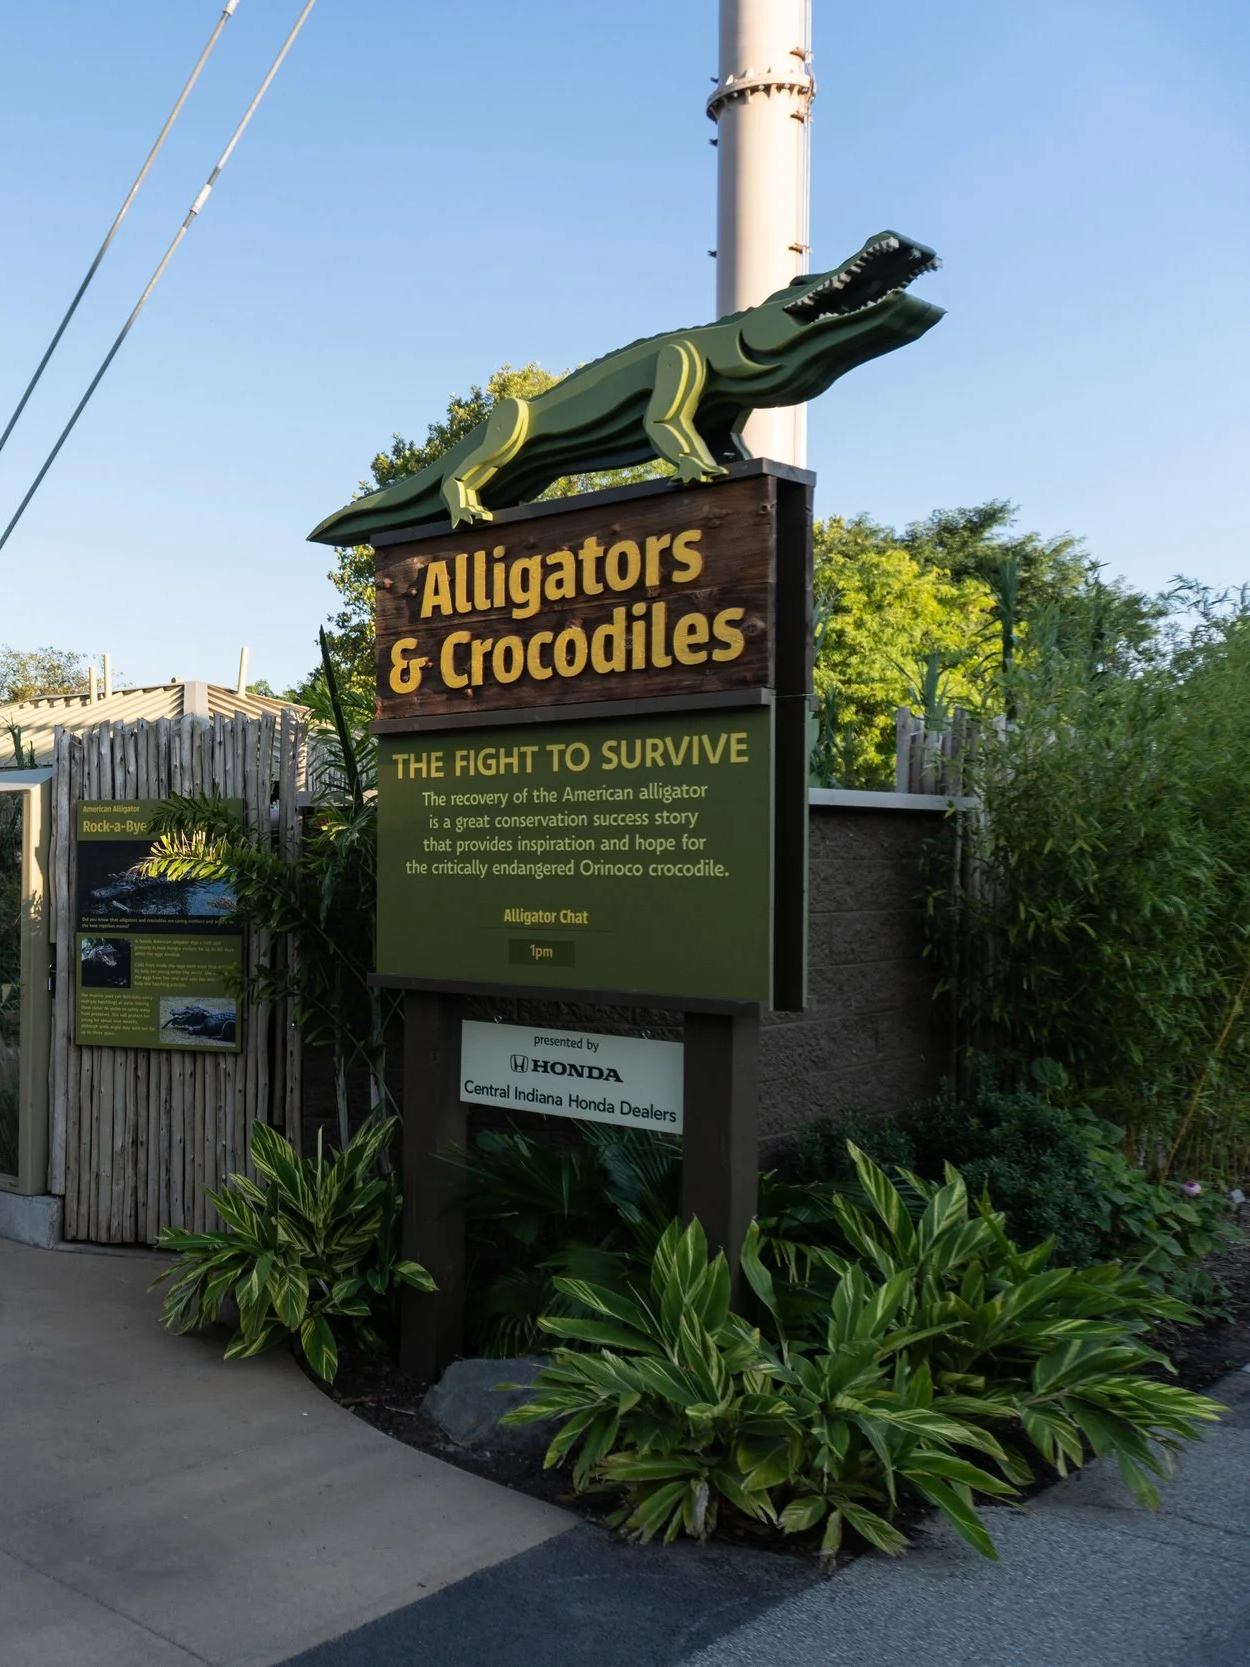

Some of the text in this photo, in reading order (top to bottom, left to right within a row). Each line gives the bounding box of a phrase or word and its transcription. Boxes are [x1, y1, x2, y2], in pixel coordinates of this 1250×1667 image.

[420, 529, 703, 620] Alligators
[389, 601, 746, 694] & Crocodiles
[393, 732, 749, 779] THE FIGHT TO SURVIVE
[422, 782, 708, 807] The recovery of the American alligator
[82, 805, 140, 814] American Alligator
[429, 809, 700, 832] is a great conservation success story
[82, 819, 148, 835] Rock-a-Bye
[423, 834, 707, 856] that provides inspiration and hope for
[405, 858, 730, 880] the critically endangered Orinoco crocodile.
[503, 908, 589, 926] Alligator Chat
[530, 944, 553, 960] 1pm
[534, 1035, 599, 1053] presented by
[531, 1058, 624, 1084] HONDA
[464, 1079, 677, 1124] Central Indiana Honda Dealers
